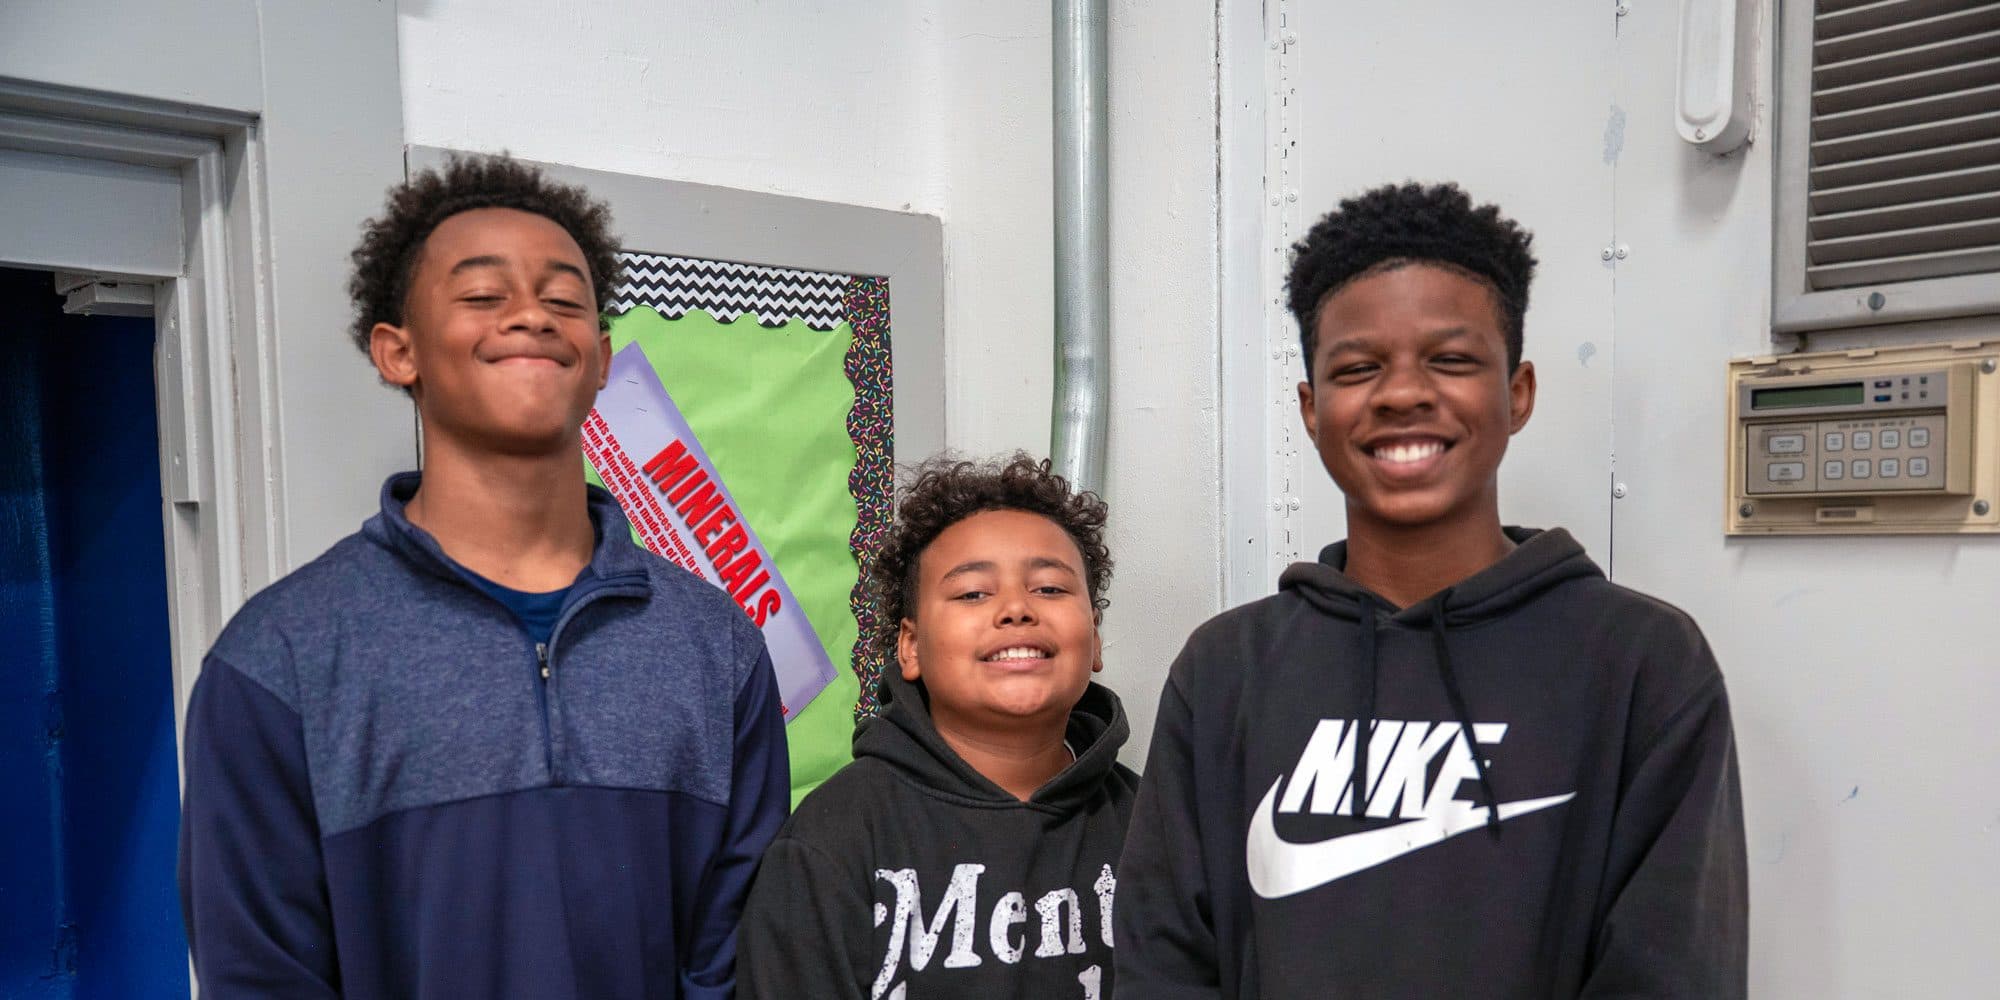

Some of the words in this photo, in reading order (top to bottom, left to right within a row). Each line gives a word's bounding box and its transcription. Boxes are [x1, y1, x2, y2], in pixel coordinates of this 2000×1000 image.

[600, 468, 619, 494] Here
[616, 493, 630, 511] are
[627, 510, 647, 538] some
[601, 447, 632, 492] Minerals
[629, 491, 643, 509] are
[640, 508, 660, 535] made
[657, 534, 669, 549] up
[666, 547, 677, 559] of
[605, 434, 620, 452] are
[618, 451, 638, 477] solid
[633, 475, 672, 531] substances
[669, 529, 691, 558] found
[685, 555, 696, 568] in
[643, 438, 781, 628] MINERALS
[1278, 719, 1508, 820] NIKE
